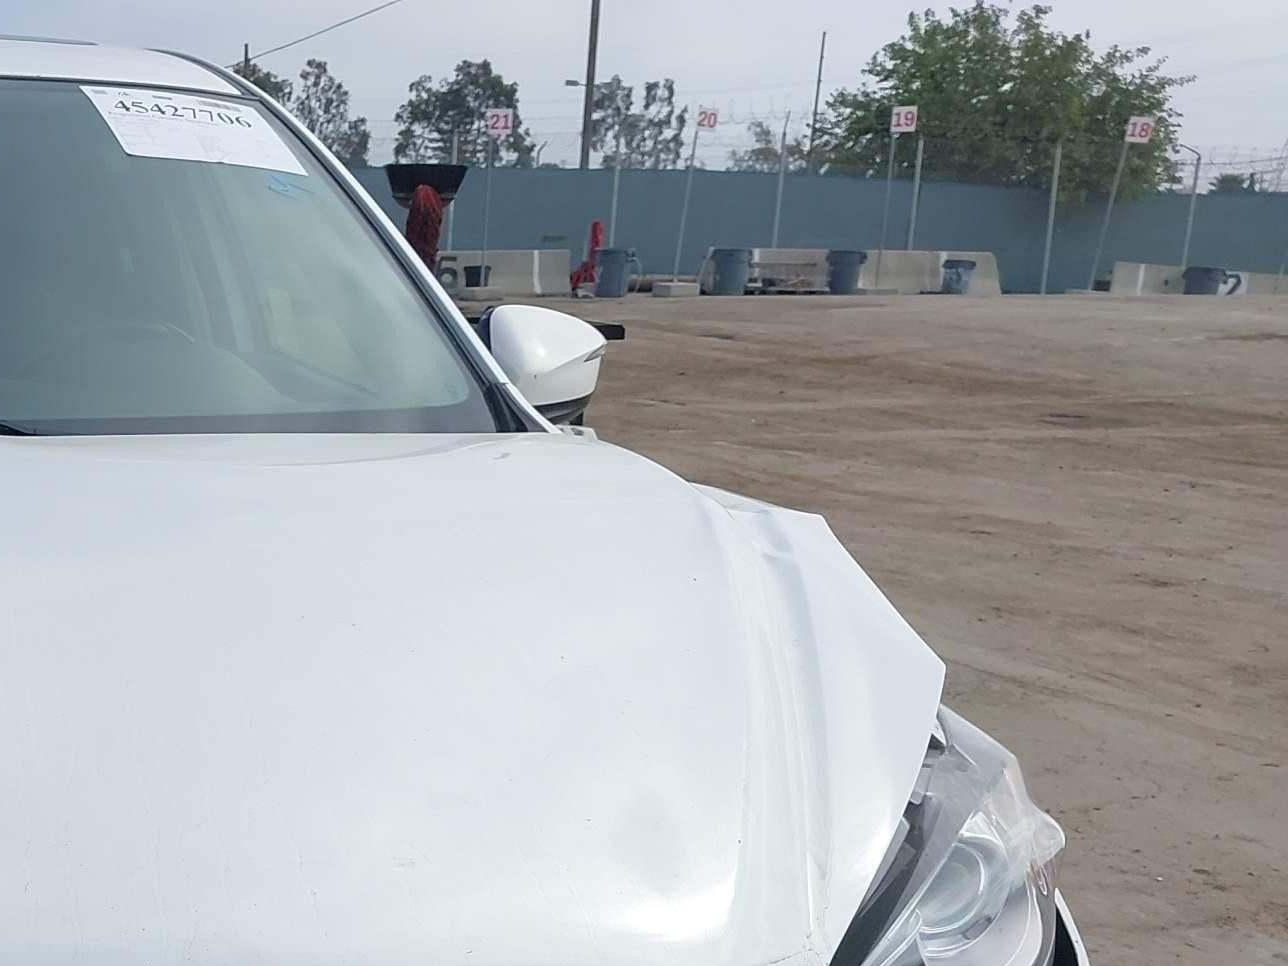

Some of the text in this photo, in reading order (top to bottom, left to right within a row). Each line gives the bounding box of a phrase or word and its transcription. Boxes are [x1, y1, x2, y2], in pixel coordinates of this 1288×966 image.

[114, 99, 252, 128] 45427706
[697, 111, 717, 128] 20
[893, 111, 915, 127] 19
[491, 114, 509, 130] 21
[1128, 122, 1151, 138] 18
